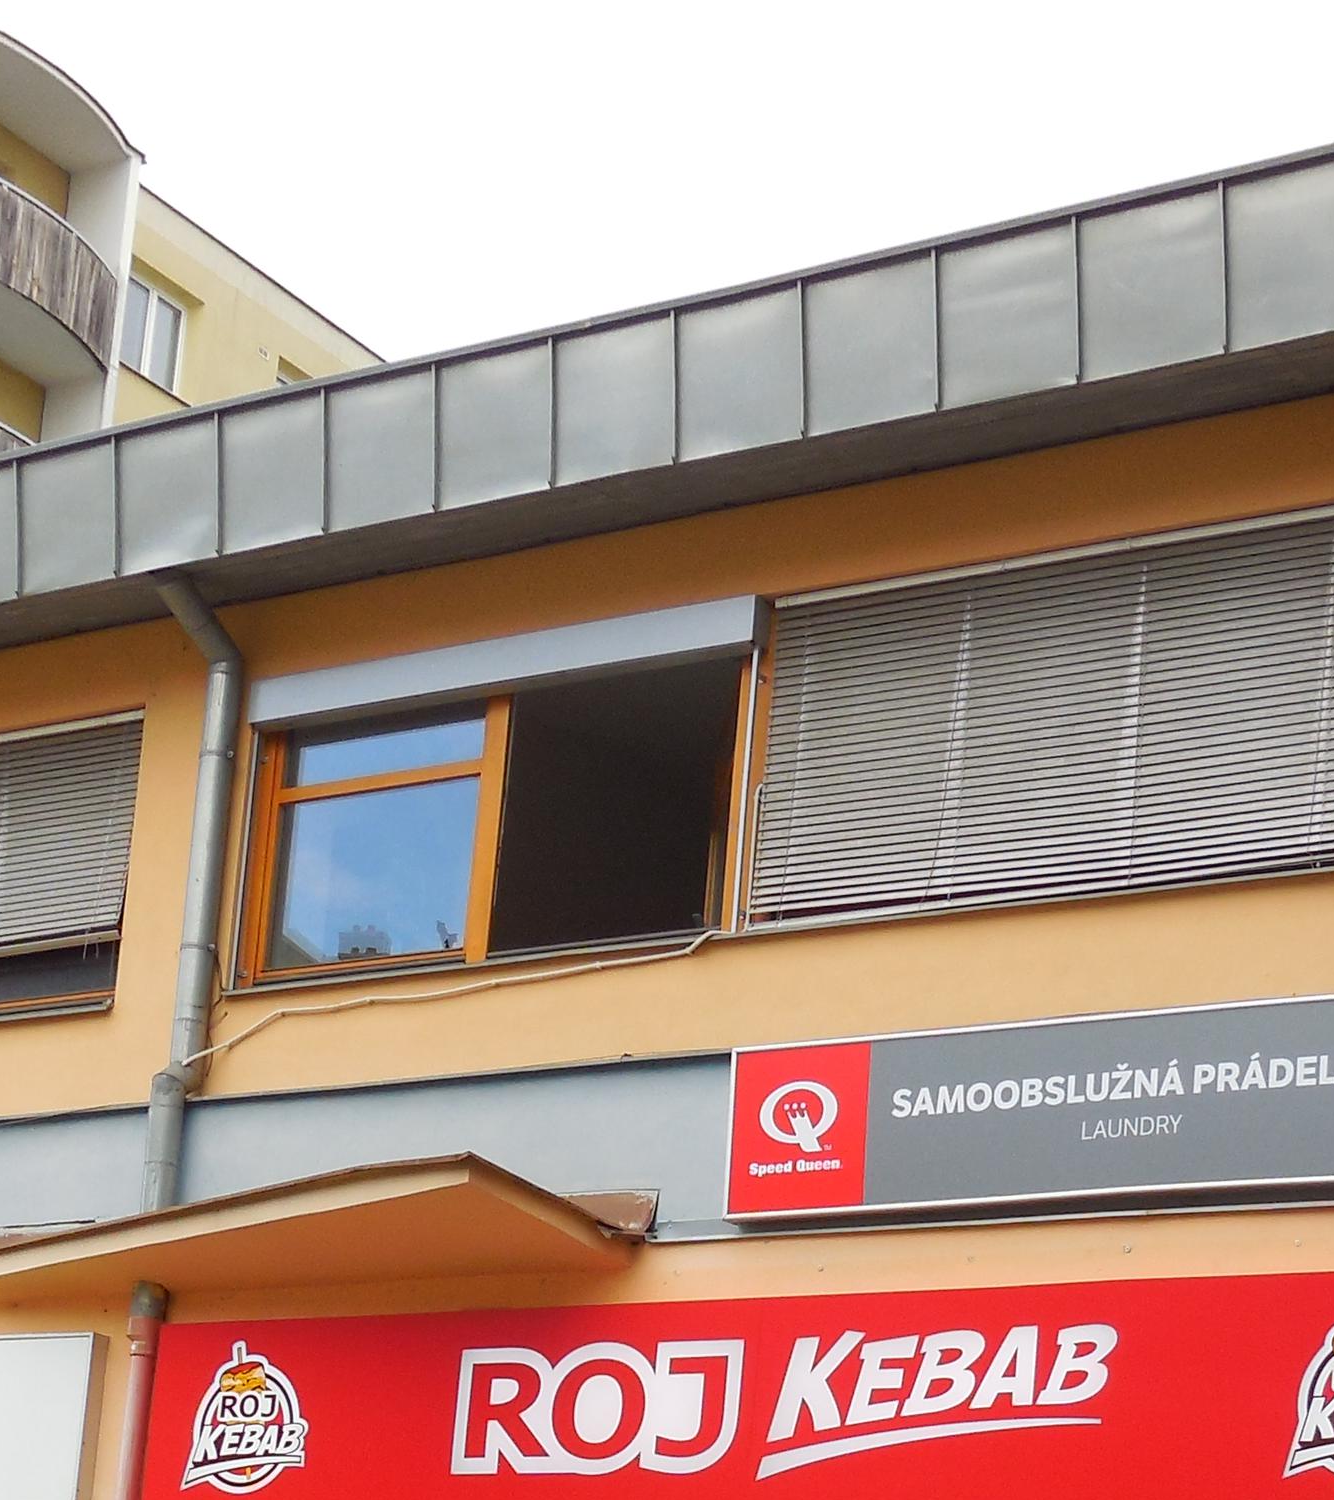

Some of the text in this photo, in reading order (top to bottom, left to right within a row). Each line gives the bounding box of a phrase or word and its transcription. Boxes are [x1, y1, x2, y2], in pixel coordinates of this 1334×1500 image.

[891, 1059, 1185, 1118] SAMOOBSLUŽNÁ
[1080, 1114, 1183, 1141] LAUNDRY
[749, 1159, 841, 1177] Speed Queen
[220, 1394, 277, 1418] ROJ
[451, 1323, 1117, 1475] ROJ KEBAB
[192, 1423, 306, 1464] KEBAB
